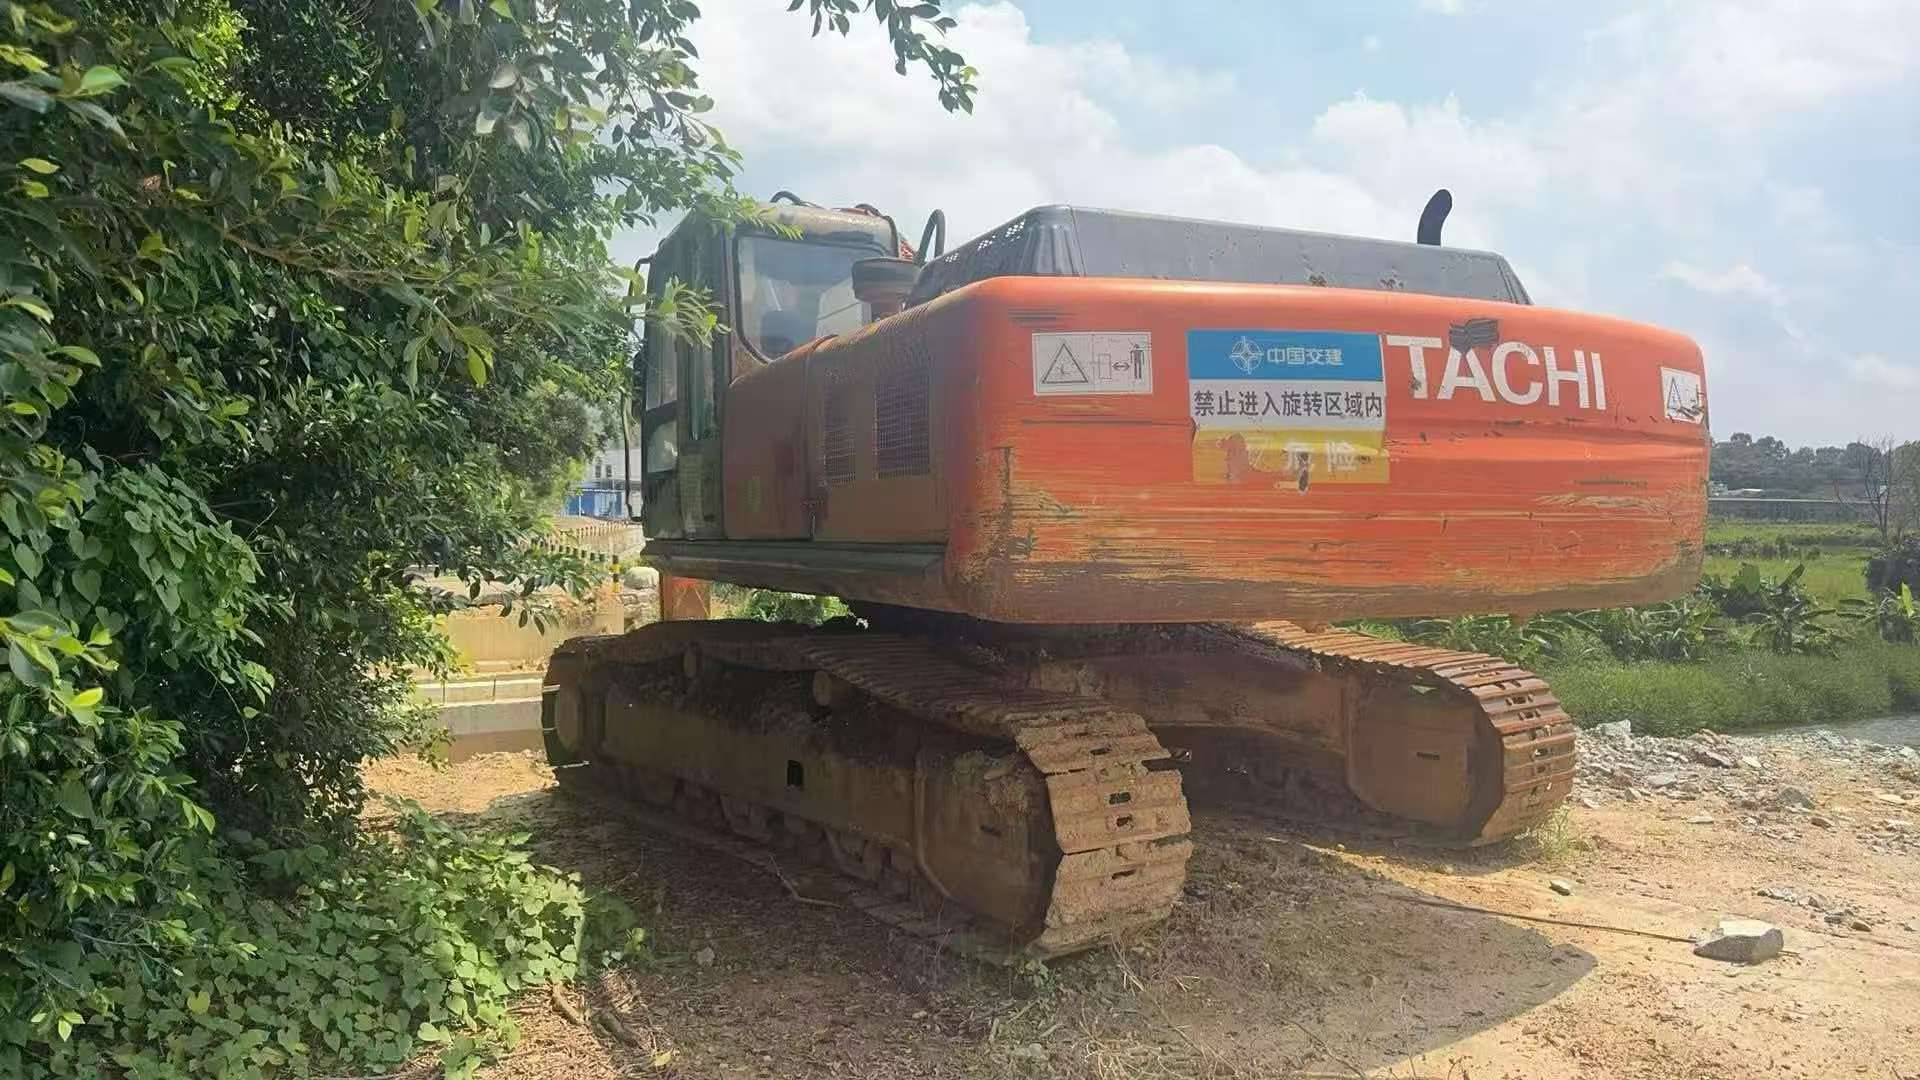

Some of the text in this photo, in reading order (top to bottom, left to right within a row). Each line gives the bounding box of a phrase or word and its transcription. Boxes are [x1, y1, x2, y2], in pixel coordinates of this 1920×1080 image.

[1267, 347, 1344, 366] 中国交建
[1387, 335, 1606, 410] TACHI
[1194, 391, 1383, 417] 禁止进入旋转区域内
